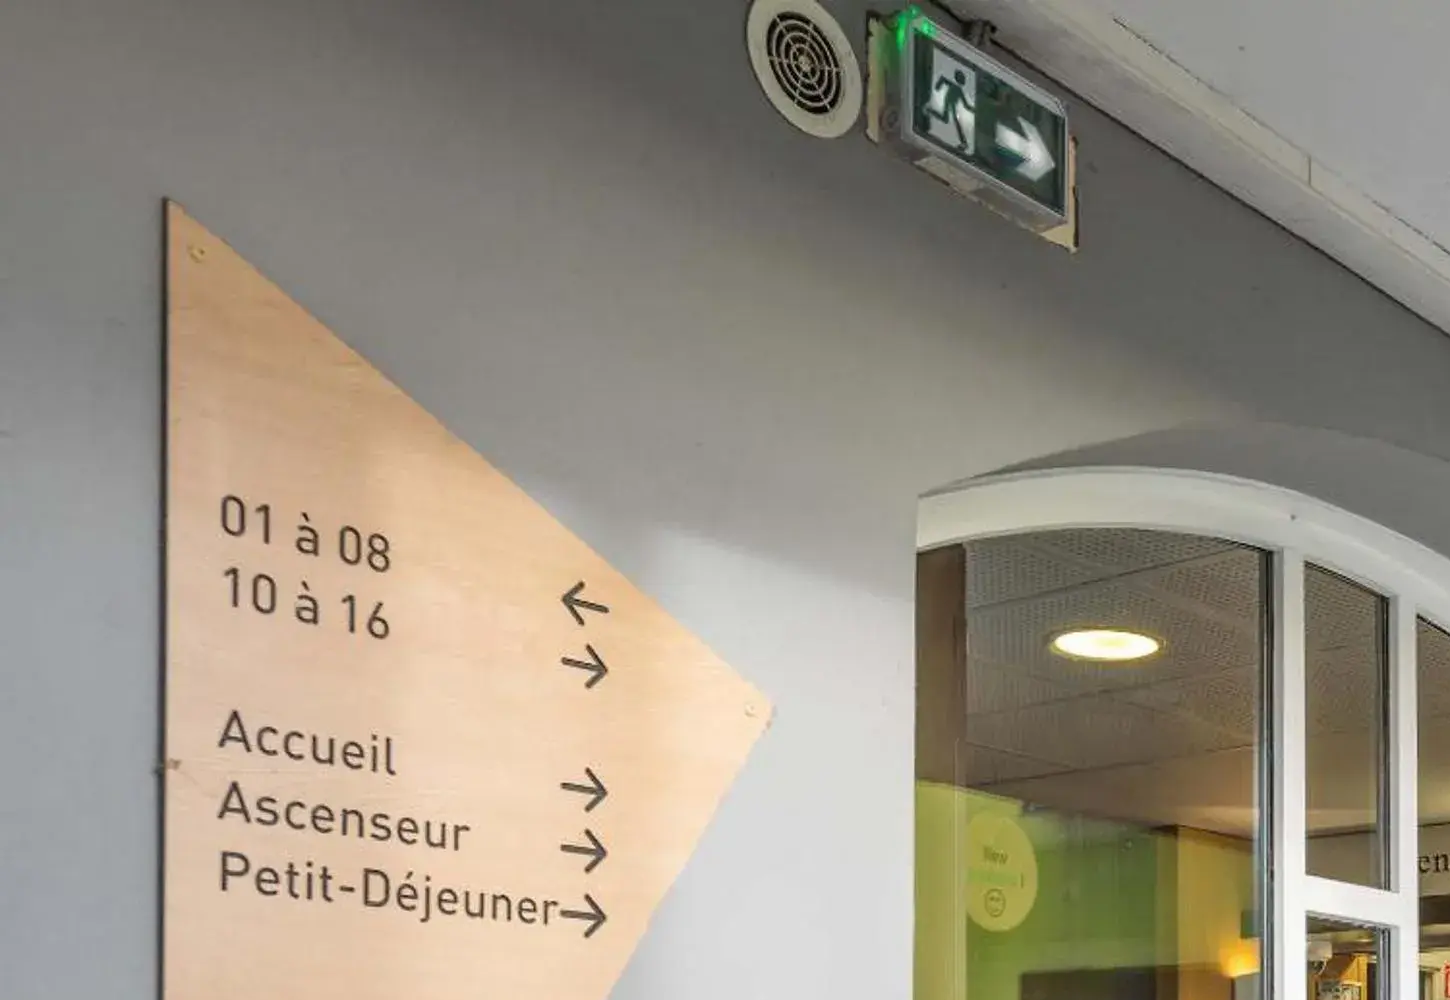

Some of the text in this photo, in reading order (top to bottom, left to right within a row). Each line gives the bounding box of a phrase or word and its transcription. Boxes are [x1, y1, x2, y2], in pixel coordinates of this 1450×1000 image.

[219, 494, 392, 573] 01 à 08
[222, 566, 391, 641] 10 à 16
[217, 709, 397, 777] Accueil
[216, 780, 471, 852] Ascenseur
[219, 850, 559, 927] Petit-Déjeuner
